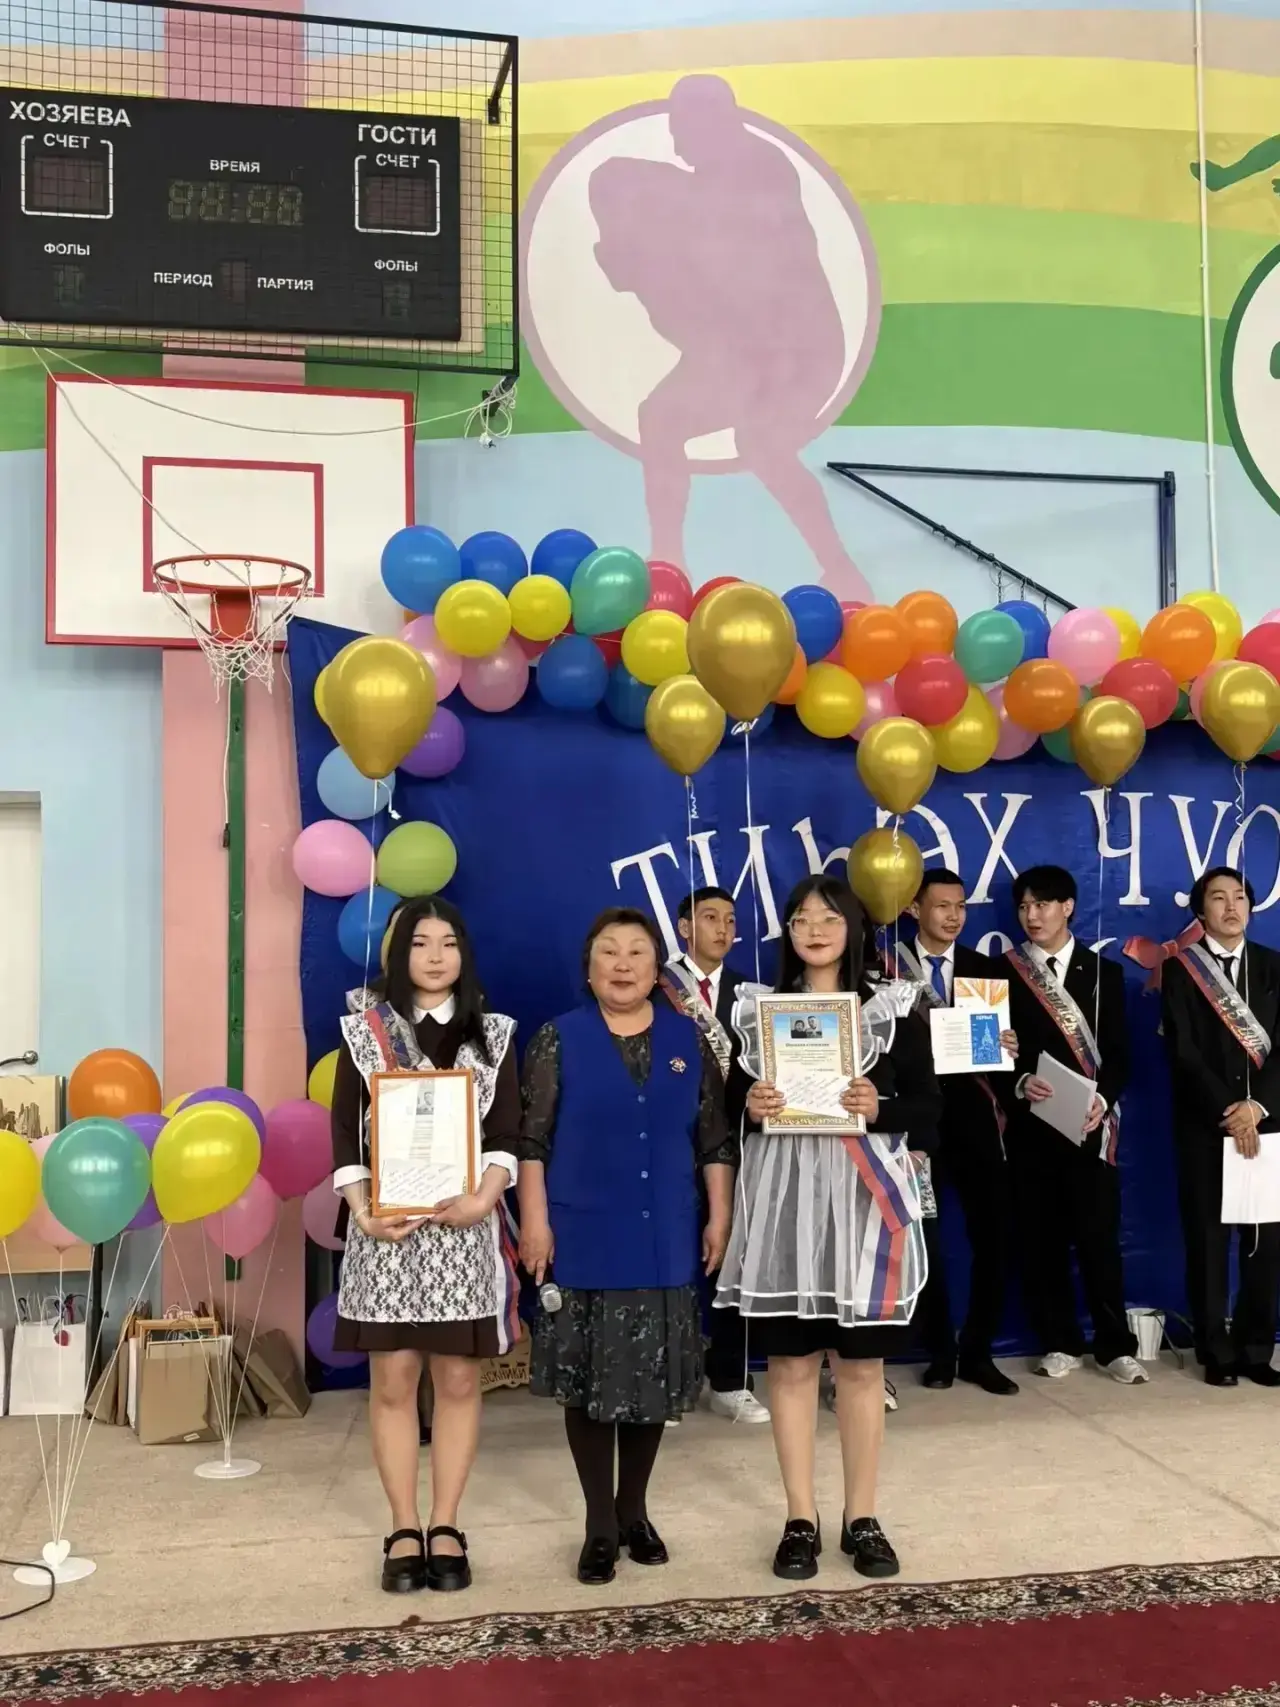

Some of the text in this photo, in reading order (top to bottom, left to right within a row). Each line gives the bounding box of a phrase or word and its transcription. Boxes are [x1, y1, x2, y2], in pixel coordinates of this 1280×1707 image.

[9, 100, 132, 128] ХОЗЯЕВА
[43, 133, 91, 149] СЧЕТ
[357, 124, 437, 147] ГОСТИ
[209, 159, 261, 174] ВРЕМЯ
[375, 153, 420, 169] СЧЕТ
[43, 241, 91, 256] ФОЛЫ
[374, 259, 419, 273] ФОЛЫ
[153, 271, 213, 288] ПЕРИОД
[257, 276, 315, 291] ПАРТИЯ
